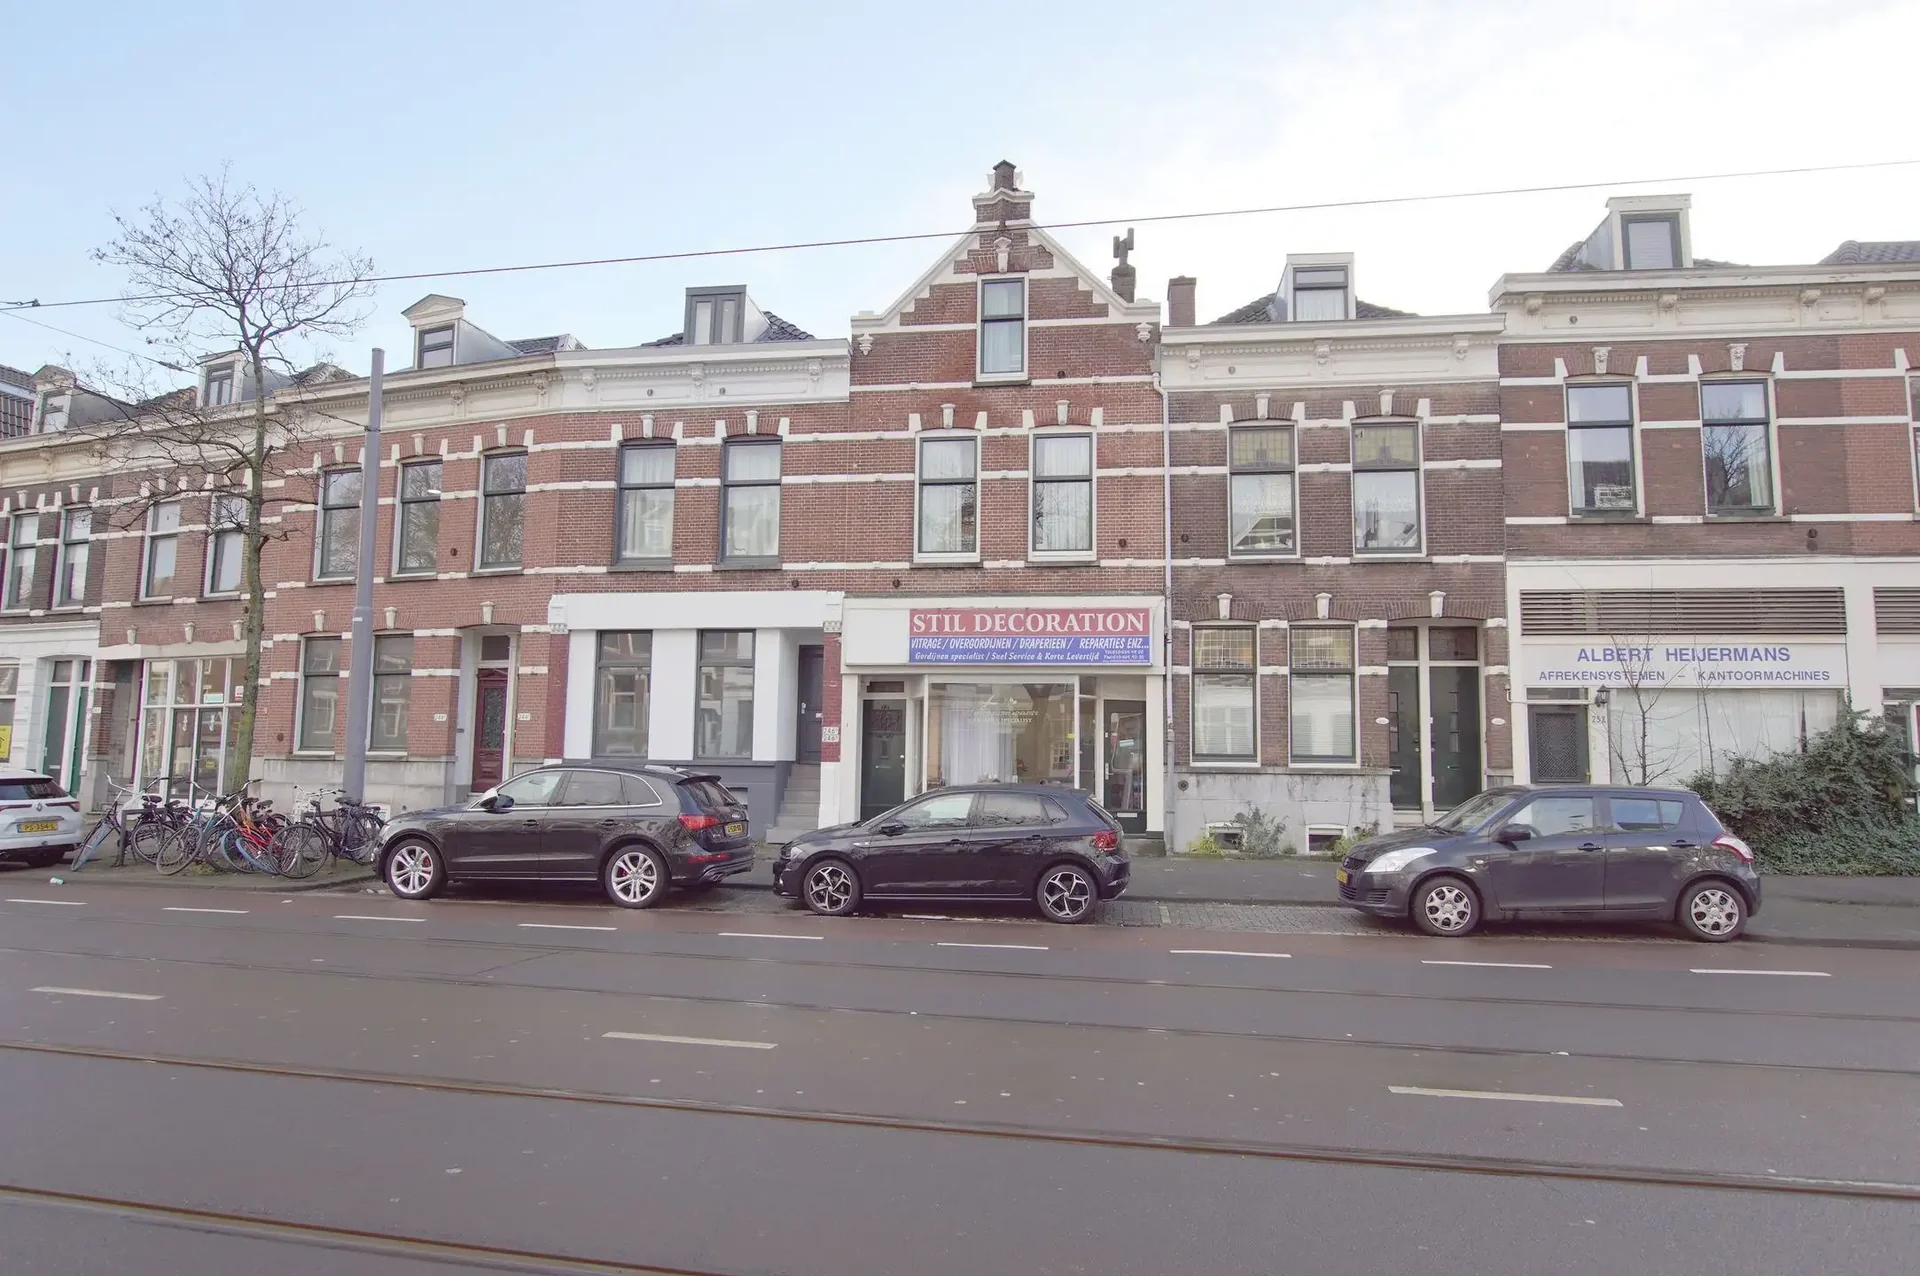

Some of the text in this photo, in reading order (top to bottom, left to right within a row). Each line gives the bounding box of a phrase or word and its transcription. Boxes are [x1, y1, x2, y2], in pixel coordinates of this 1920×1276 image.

[913, 612, 1145, 633] STIL DECORATION
[911, 638, 942, 649] VITRAGE
[949, 638, 1012, 649] OVERGORDIJNEN
[1019, 637, 1067, 649] DRAPERIEEN
[1079, 637, 1125, 649] REPARATIES
[915, 652, 949, 661] Gordijnen
[950, 652, 984, 661] specialist
[991, 652, 1007, 660] Snel
[1008, 652, 1035, 660] Service
[1044, 652, 1064, 660] Korte
[1066, 652, 1100, 661] Levertijd
[1577, 647, 1791, 662] ALBERT HEIJERMANS
[1539, 670, 1666, 681] AFREKENSYSTEMEN
[1698, 670, 1831, 681] KANTOORMACHINES
